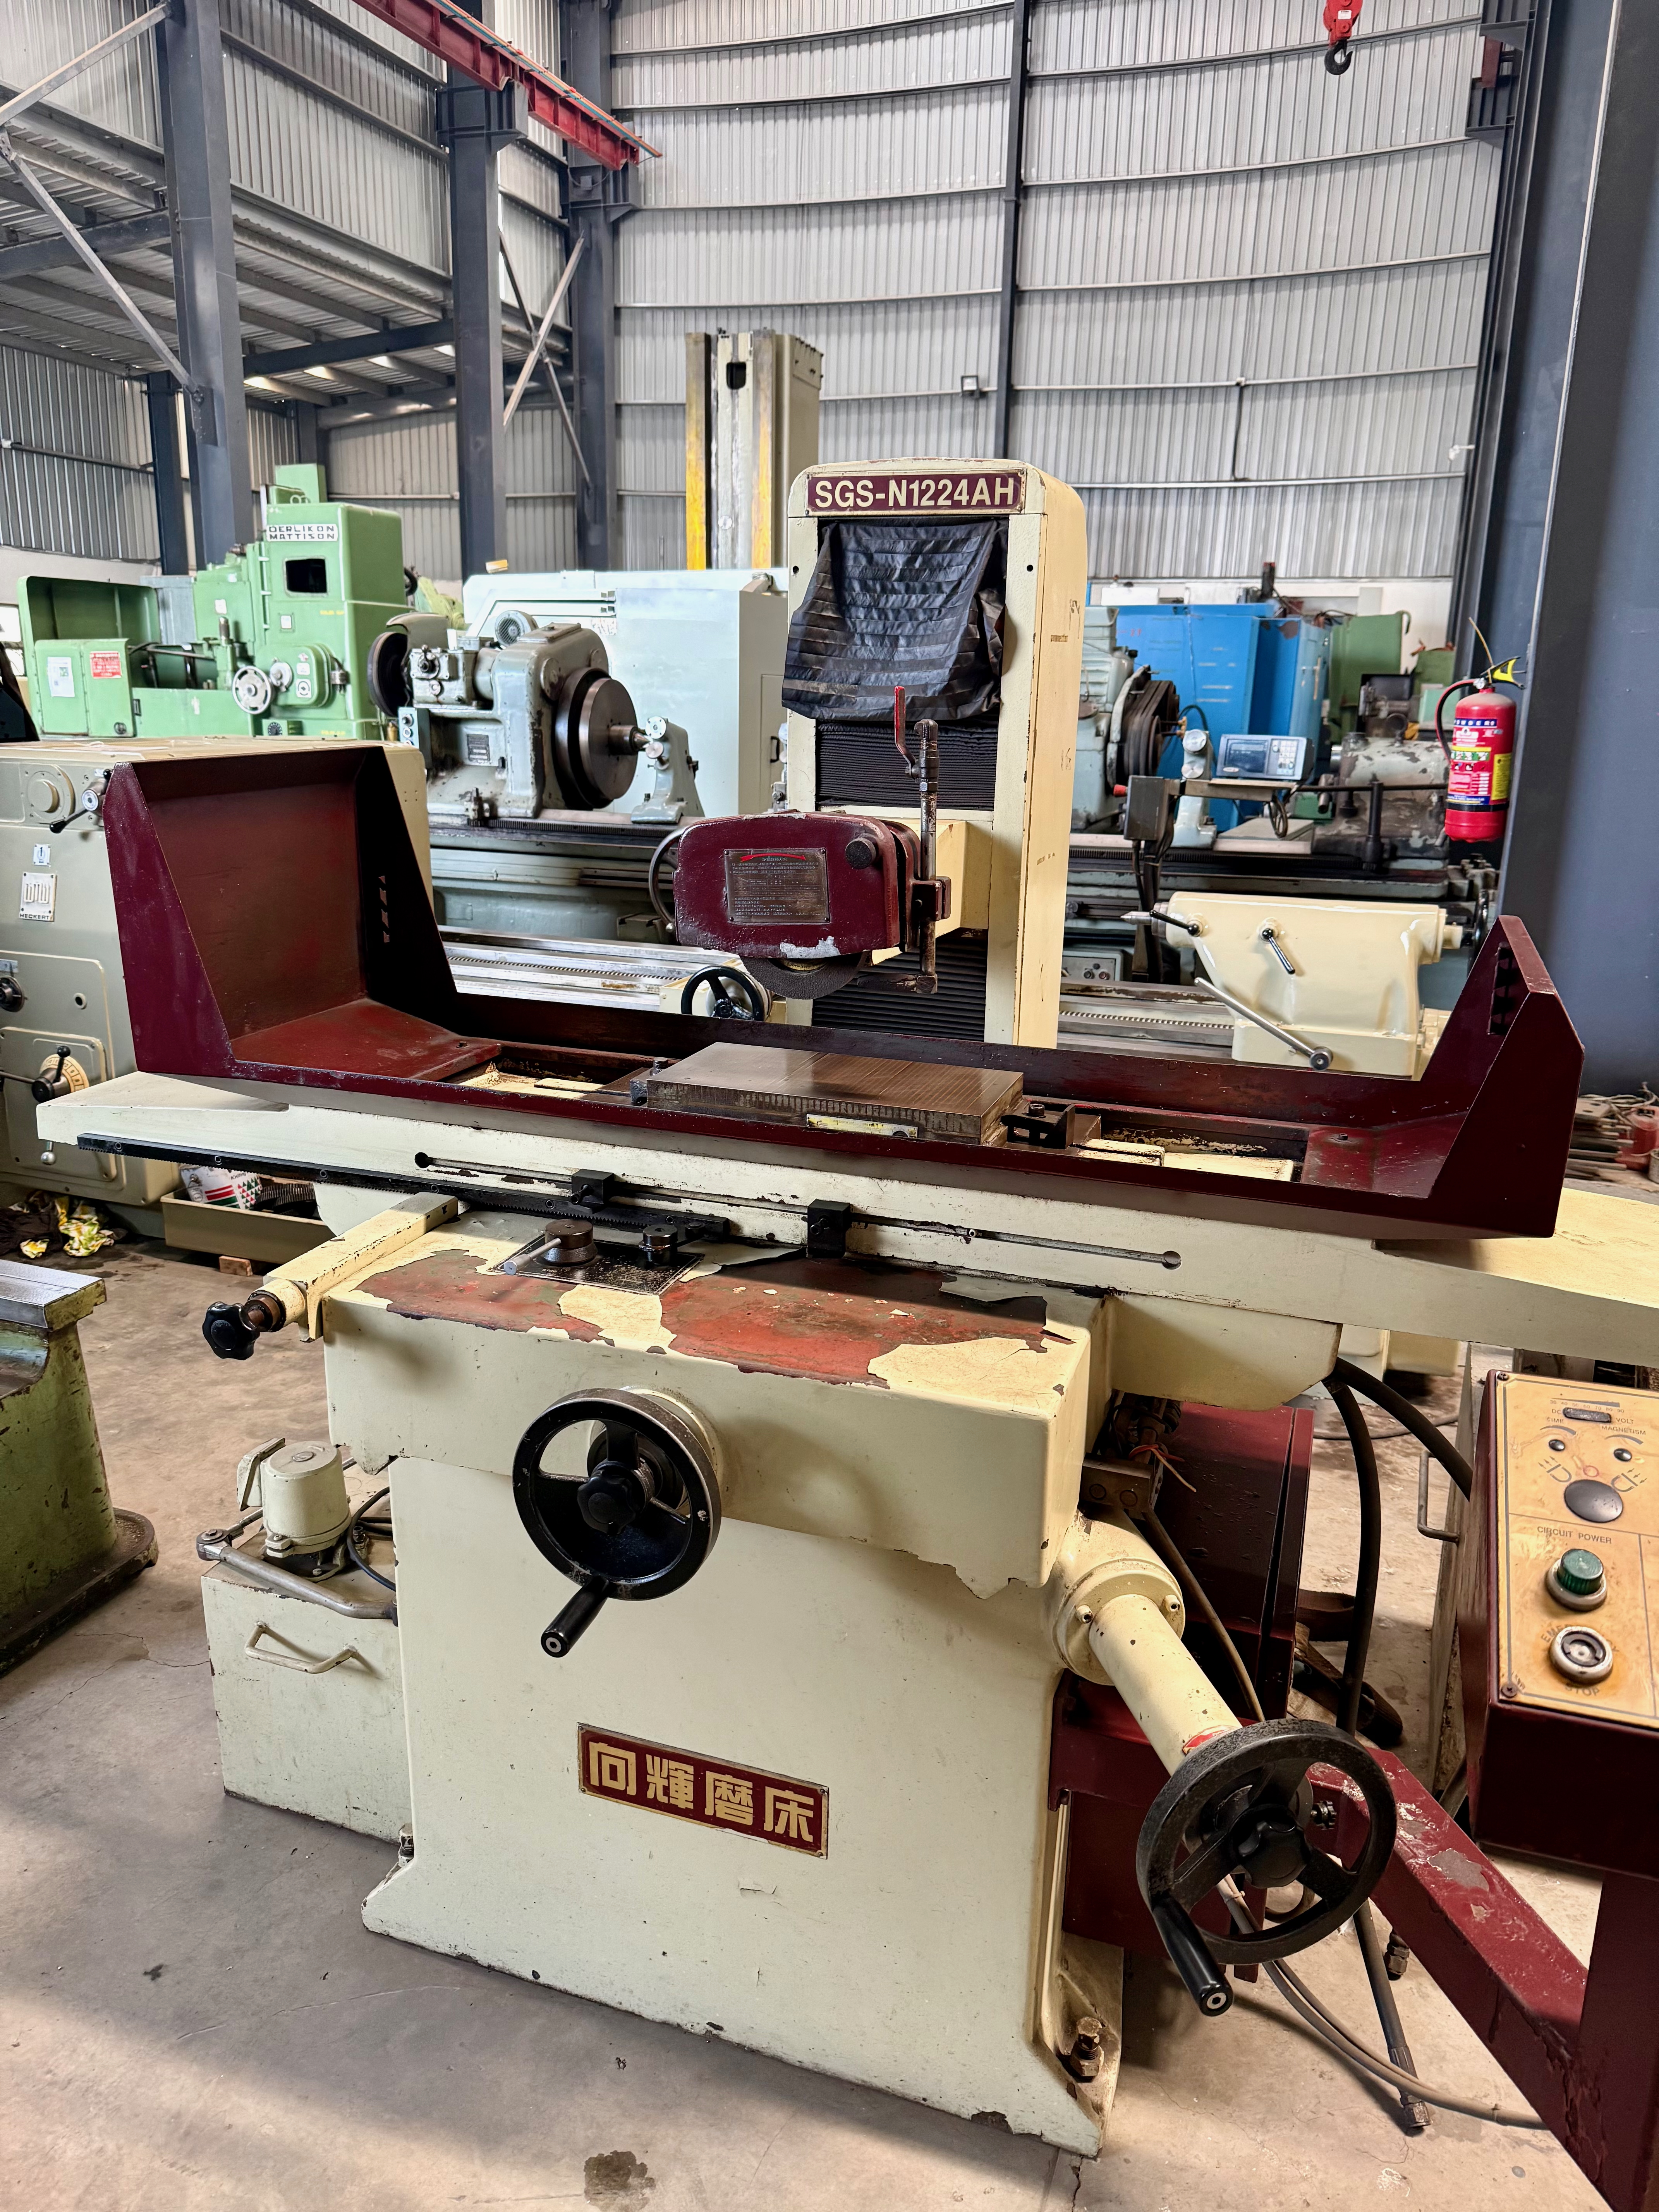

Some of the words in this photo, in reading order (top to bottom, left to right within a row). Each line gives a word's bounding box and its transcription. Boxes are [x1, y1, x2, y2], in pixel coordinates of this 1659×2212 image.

[815, 477, 1015, 508] SGS-N1224AH
[1601, 1425, 1646, 1435] MAGNETISM
[1537, 1526, 1573, 1538] CIRCUIT
[1578, 1532, 1612, 1544] POWER
[589, 1741, 814, 1843] 向輝磨床
